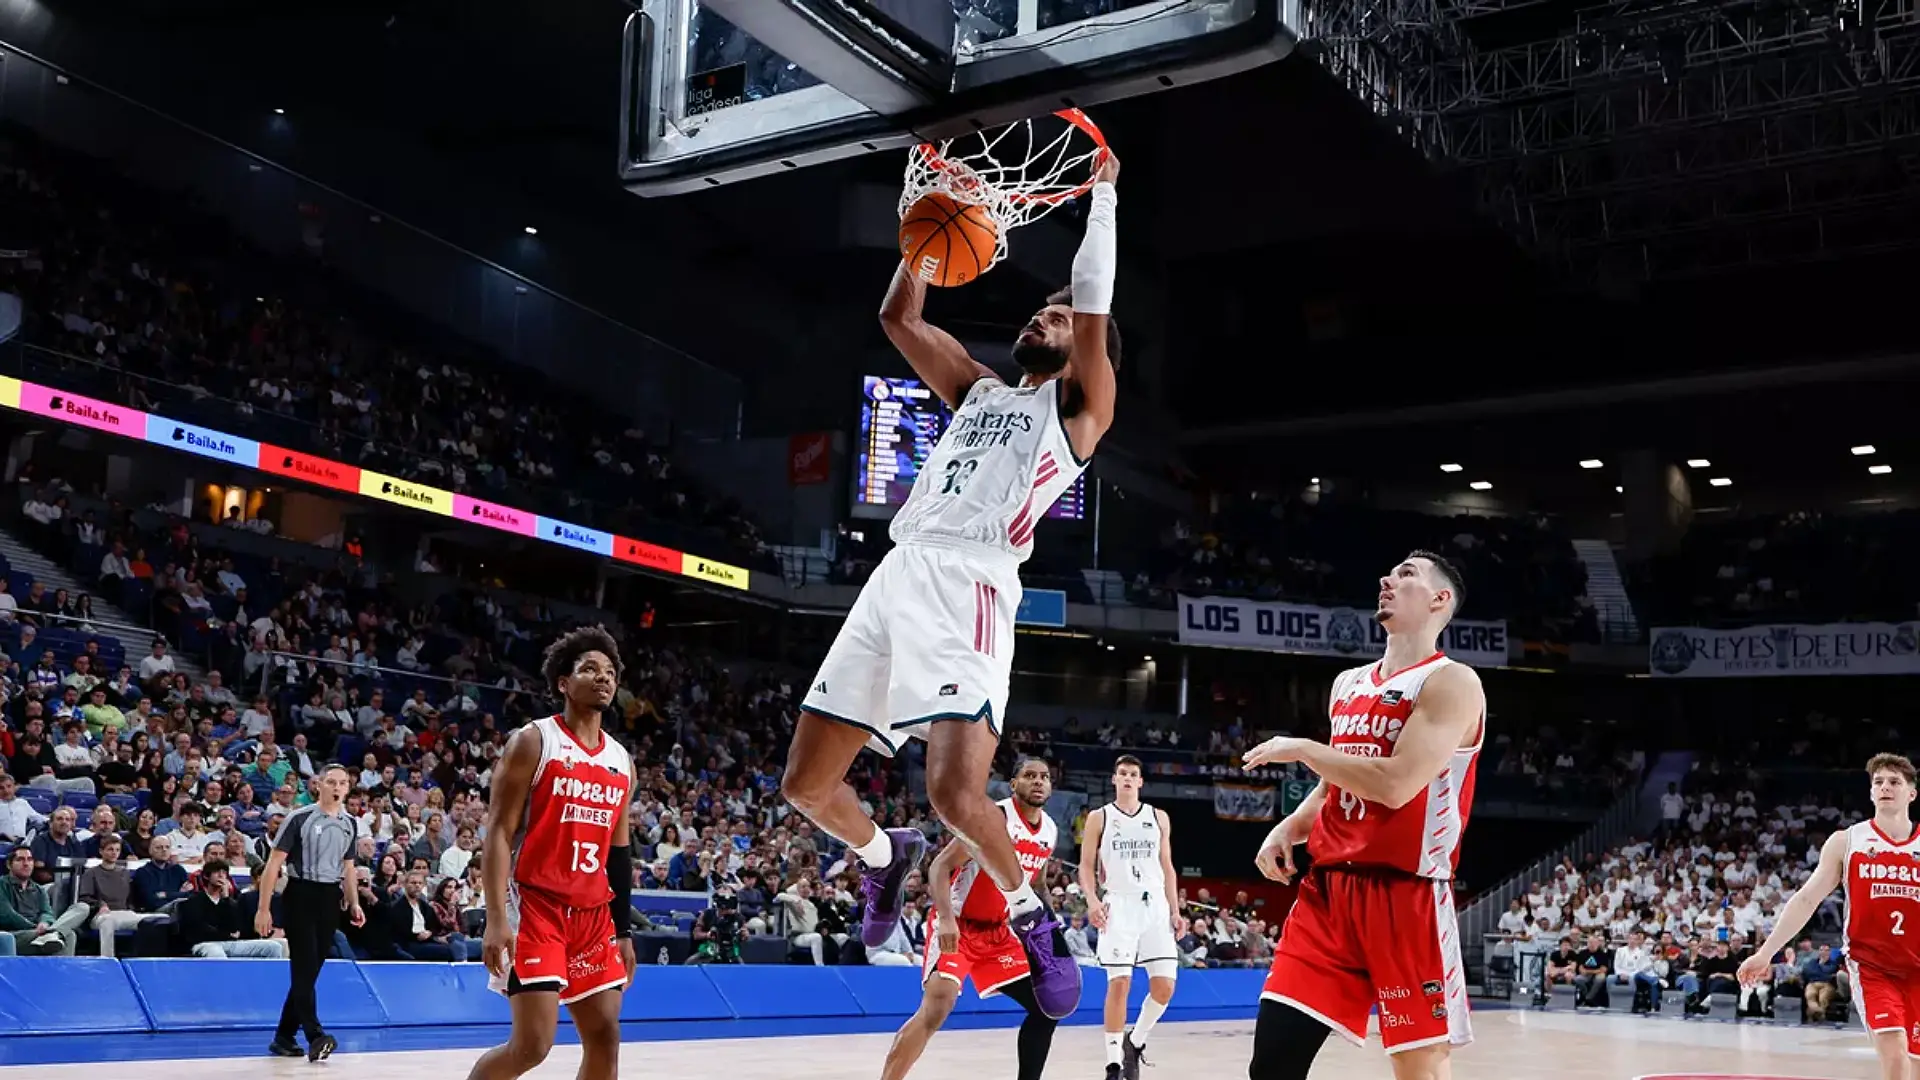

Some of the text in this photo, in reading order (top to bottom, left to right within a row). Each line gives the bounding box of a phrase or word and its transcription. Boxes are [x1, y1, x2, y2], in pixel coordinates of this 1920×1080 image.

[66, 400, 120, 426] Baila.fm
[187, 432, 235, 455] Baila.fm
[295, 460, 339, 481] Baila.fm
[393, 486, 433, 506] Baila.fm
[482, 507, 520, 526] Baila.fm
[563, 528, 597, 546] Baila.fm
[1187, 604, 1240, 633] LOS
[1256, 609, 1322, 639] OJOS
[1692, 636, 1774, 660] REYES
[1792, 634, 1829, 657] DE
[571, 840, 600, 873] 13
[1132, 865, 1141, 882] 4
[1890, 911, 1905, 935] 2
